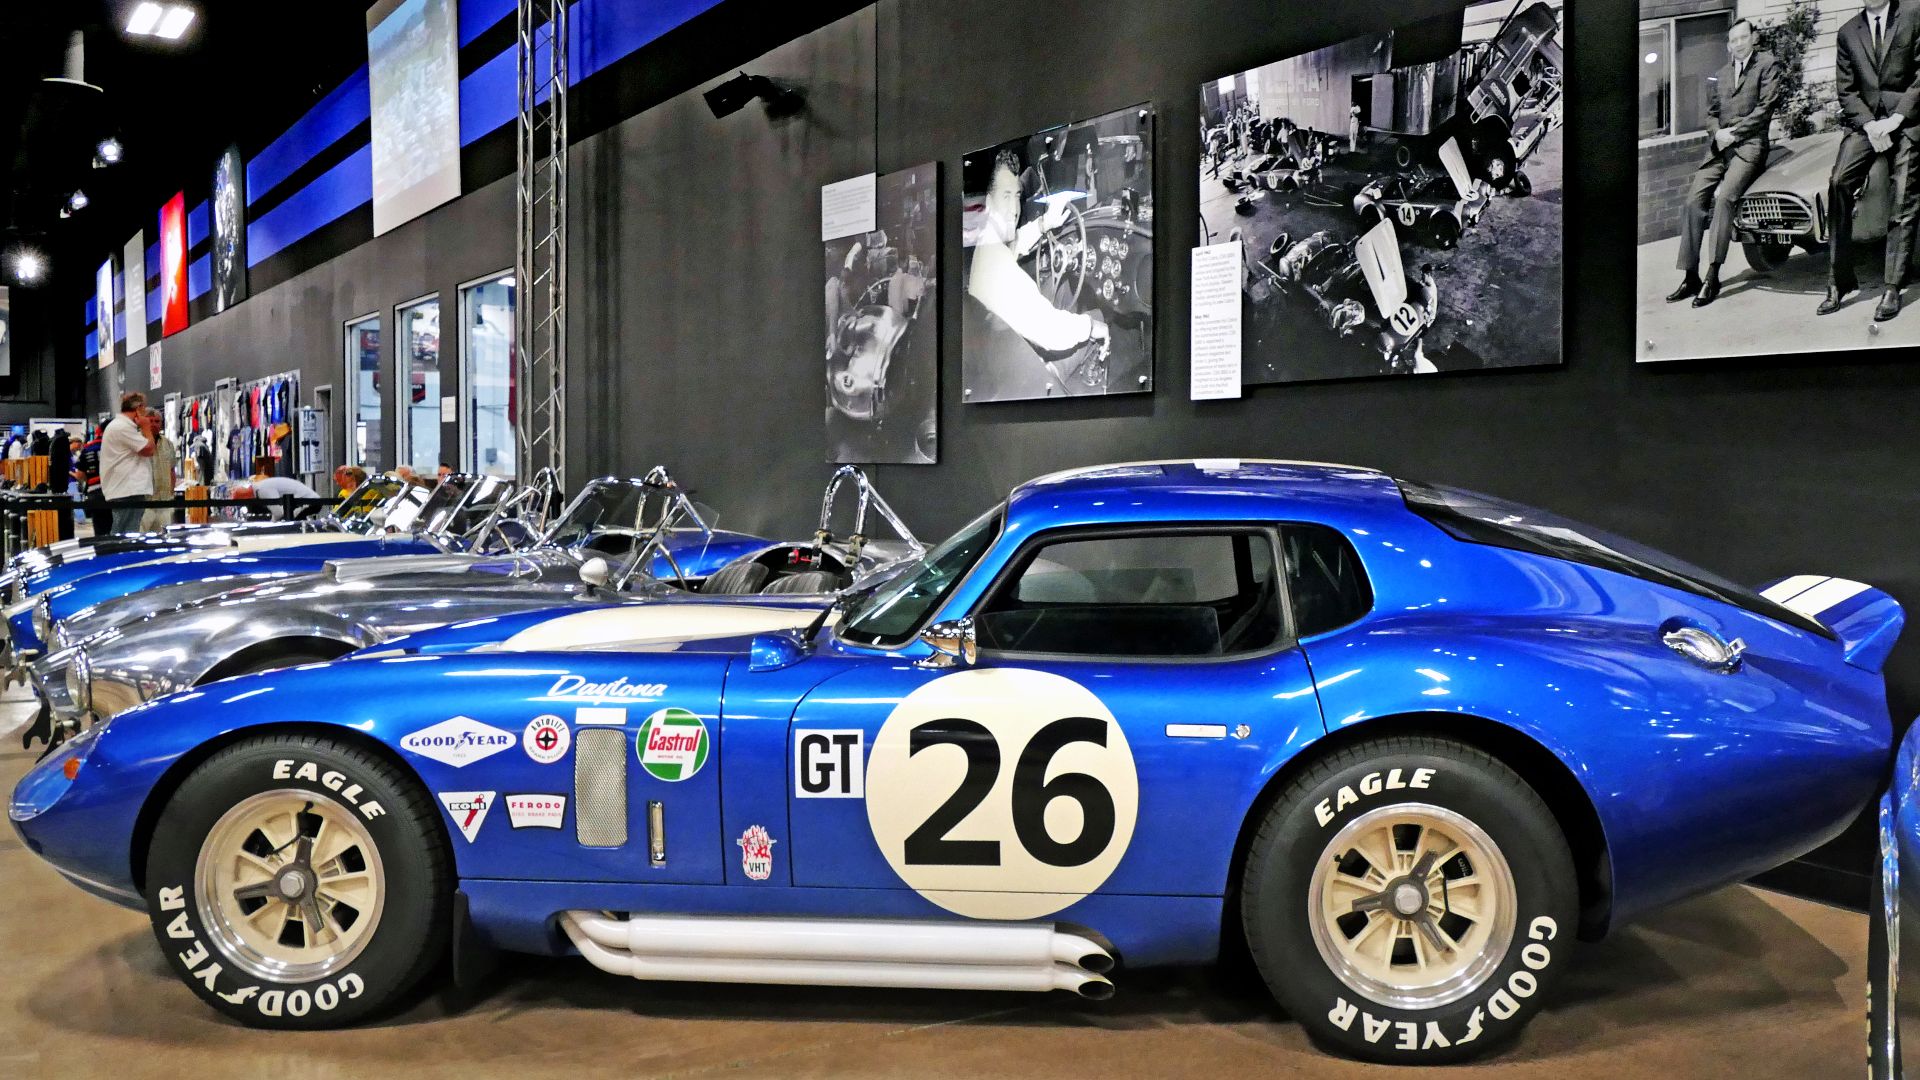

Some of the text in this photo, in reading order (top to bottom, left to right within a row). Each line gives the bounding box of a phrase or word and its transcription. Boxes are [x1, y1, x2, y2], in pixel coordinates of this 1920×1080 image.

[1402, 207, 1412, 222] 14
[1394, 306, 1417, 331] 12
[546, 675, 669, 705] Daytona
[648, 727, 701, 752] Castrol
[800, 733, 859, 794] GT
[272, 759, 387, 820] EAGLE
[903, 716, 1116, 867] 26
[1313, 767, 1437, 828] EAGLE
[450, 802, 486, 811] KONI
[511, 801, 561, 810] FERODO
[748, 862, 766, 873] VHT
